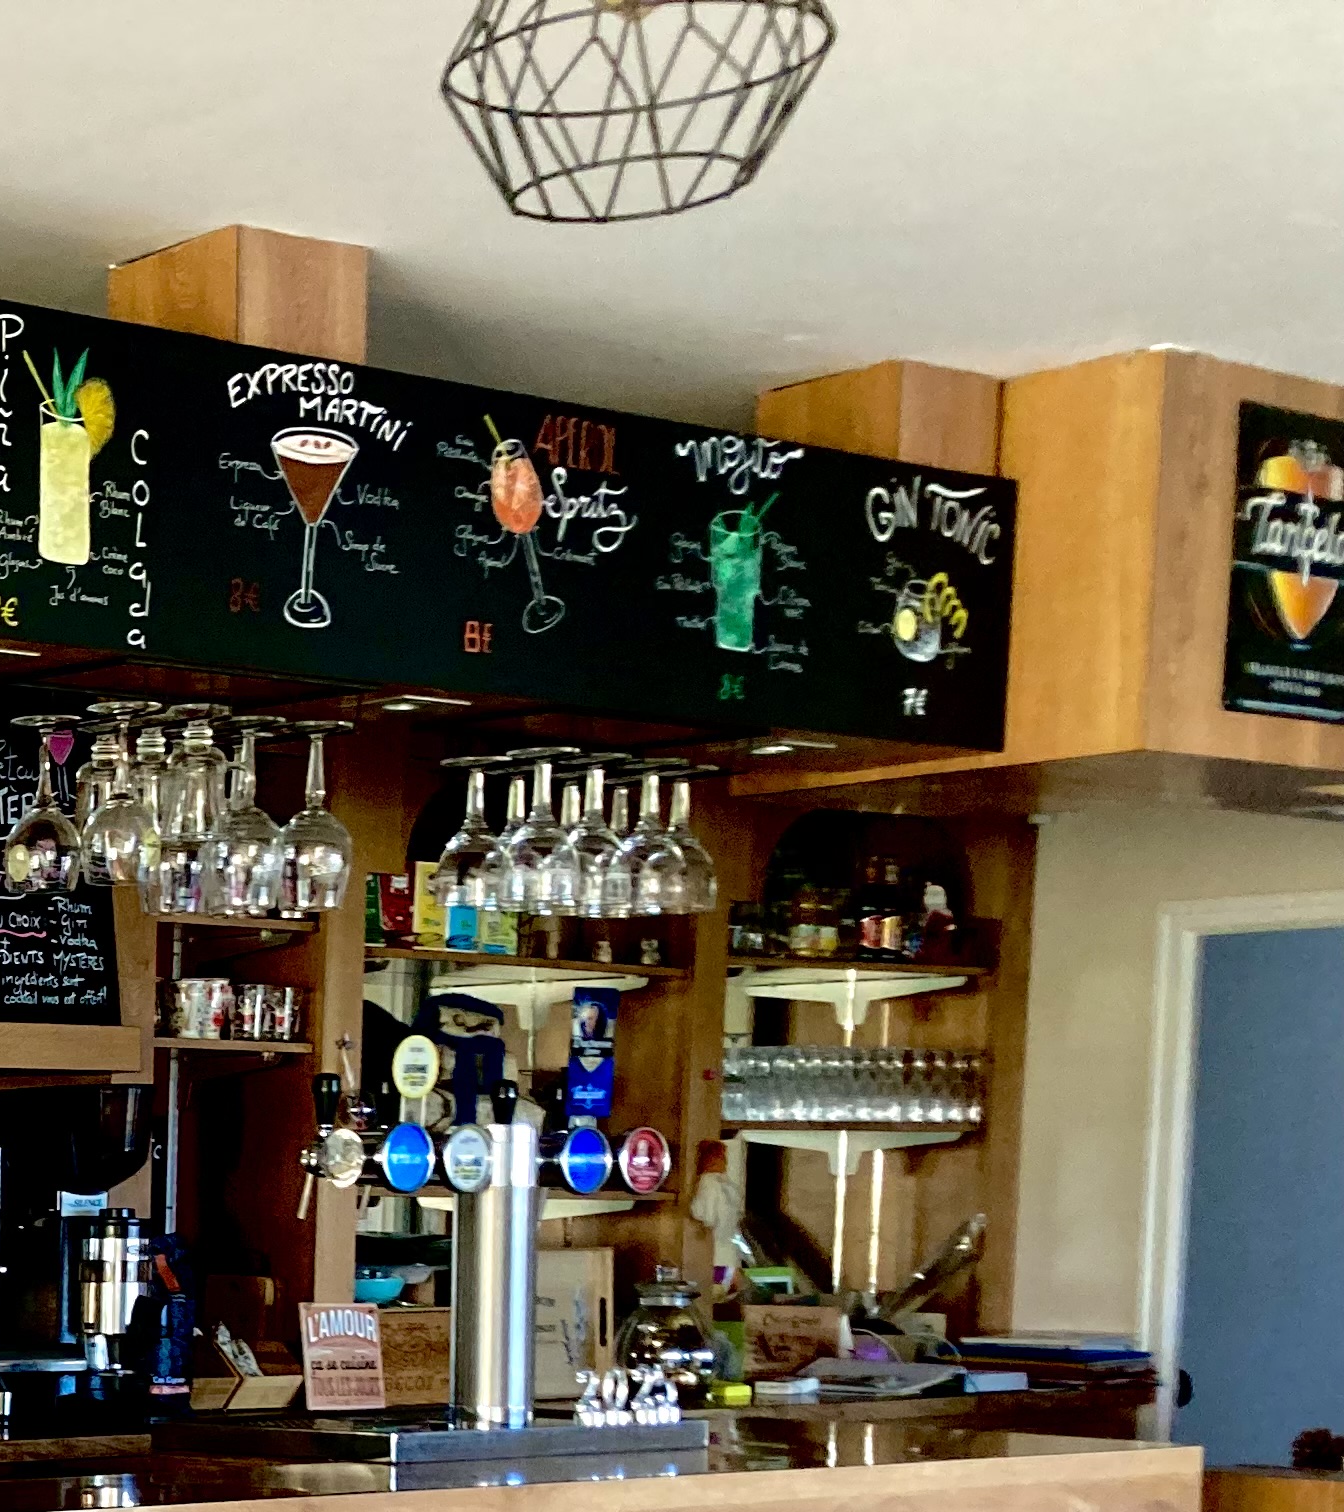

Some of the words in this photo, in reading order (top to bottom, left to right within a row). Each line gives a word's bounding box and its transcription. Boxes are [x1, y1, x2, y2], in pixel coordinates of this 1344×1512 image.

[226, 361, 355, 409] EXPRESSO
[356, 483, 400, 510] Vodka
[543, 465, 637, 553] Spritz
[463, 620, 493, 653] 8€
[57, 896, 93, 916] Rhum
[307, 1309, 377, 1343] L'AMOUR
